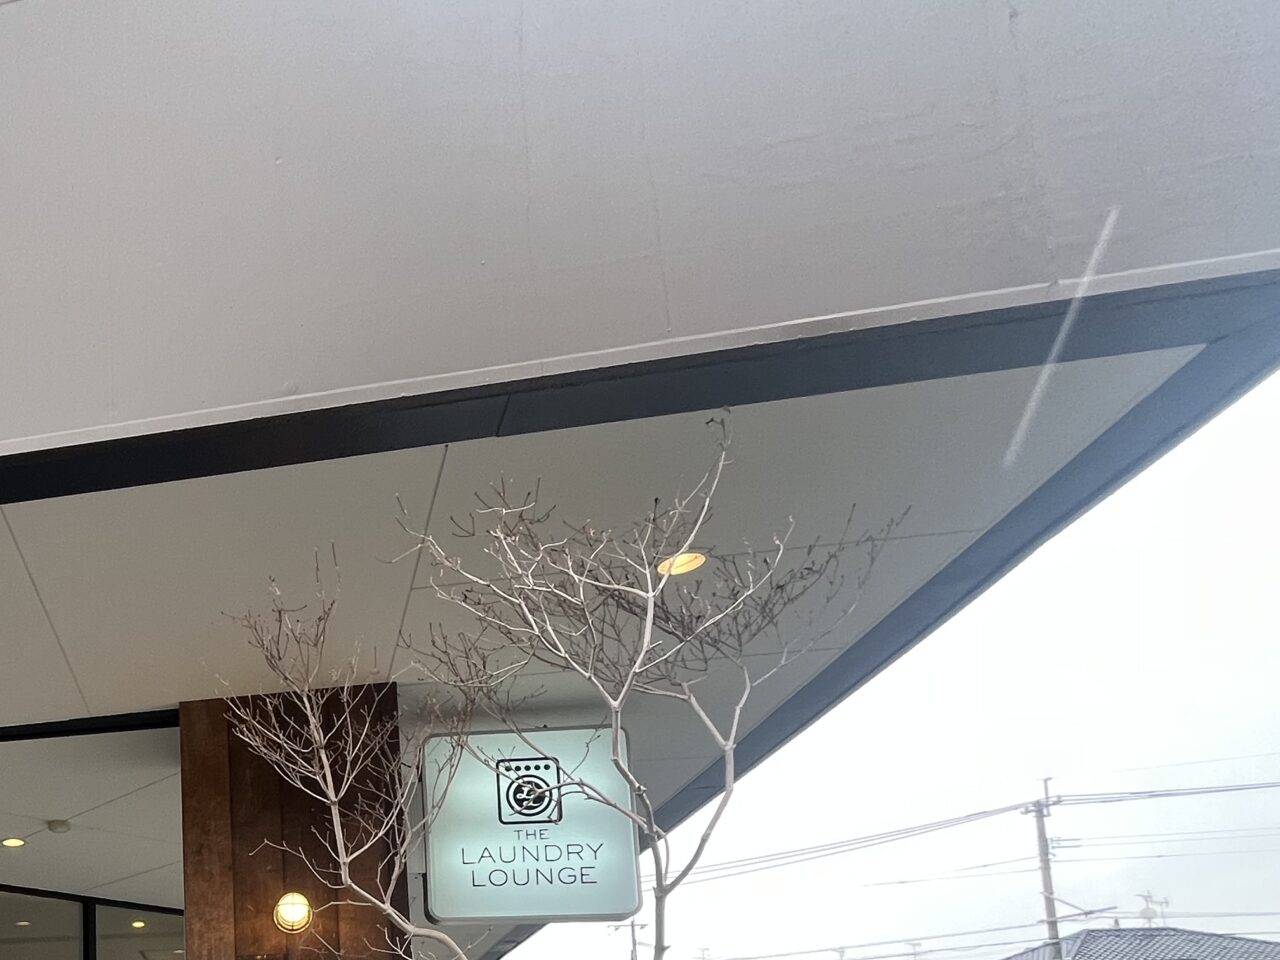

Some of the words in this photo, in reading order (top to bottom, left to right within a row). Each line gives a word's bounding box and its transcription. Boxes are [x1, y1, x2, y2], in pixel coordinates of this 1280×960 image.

[514, 829, 549, 840] THE
[461, 843, 604, 864] LAUNDRY
[472, 867, 598, 887] LOUNGE
